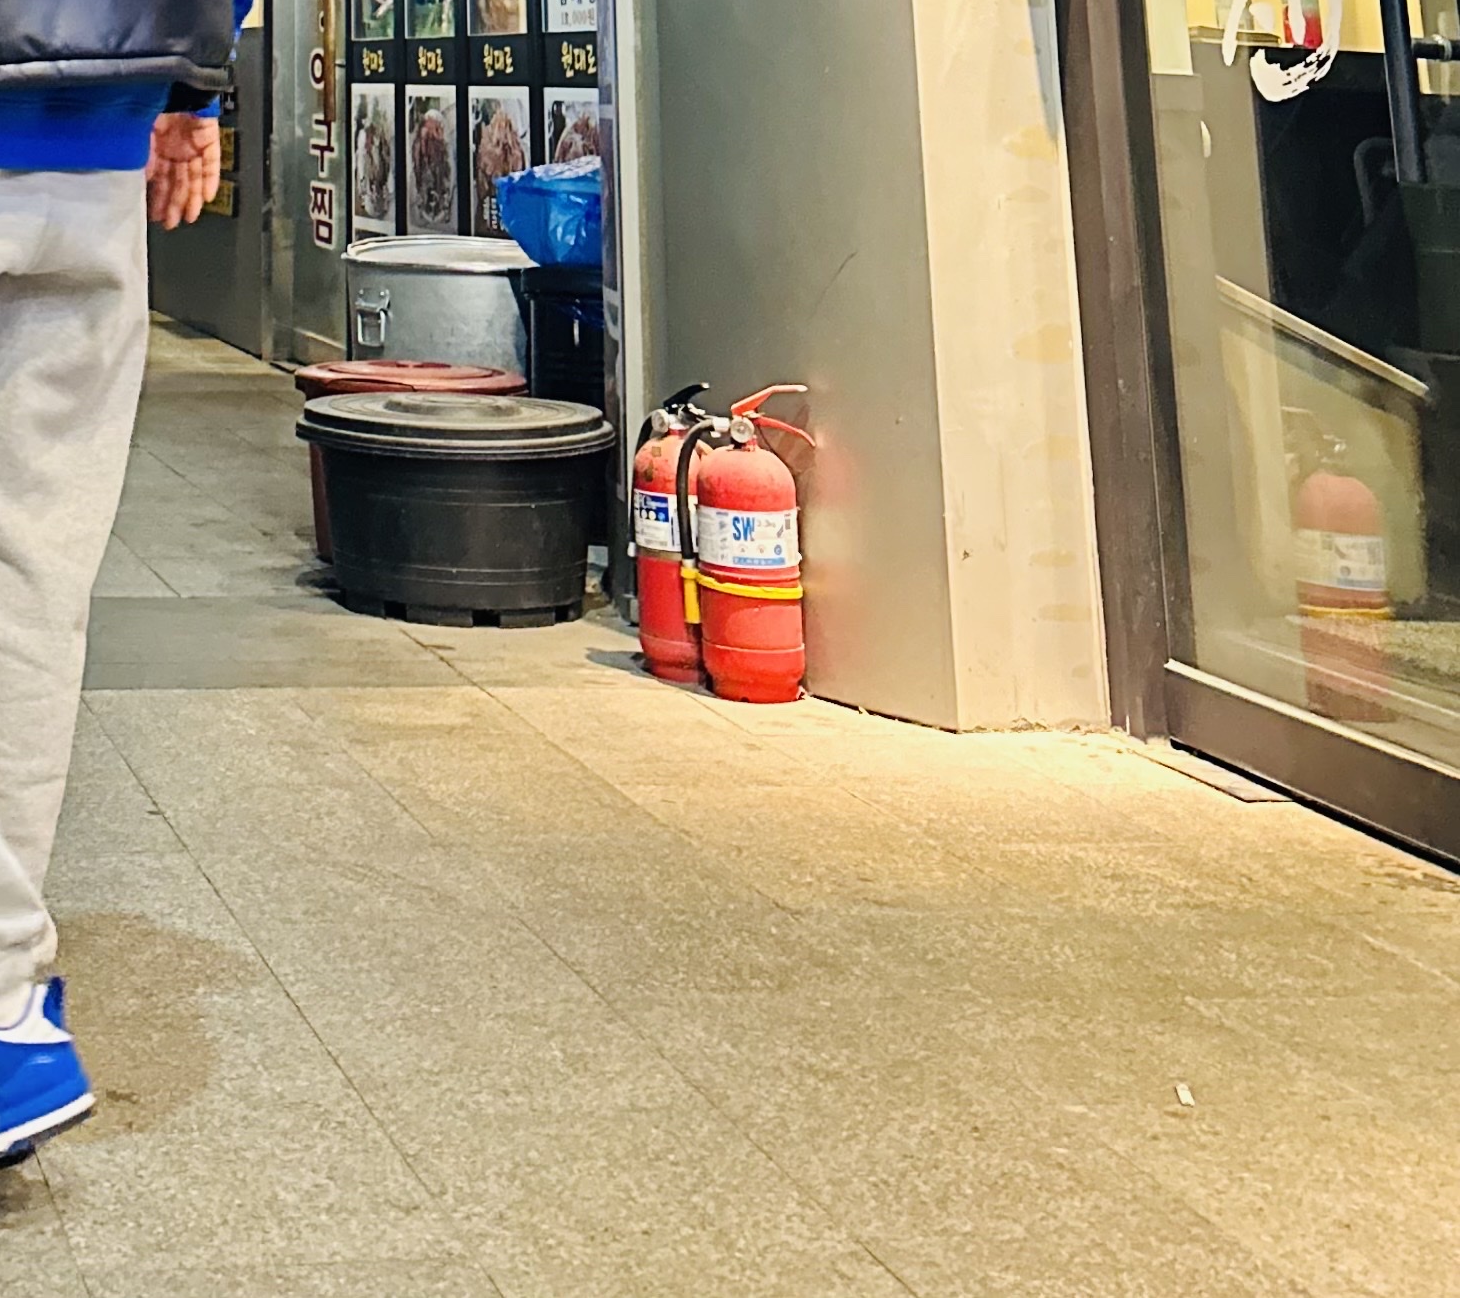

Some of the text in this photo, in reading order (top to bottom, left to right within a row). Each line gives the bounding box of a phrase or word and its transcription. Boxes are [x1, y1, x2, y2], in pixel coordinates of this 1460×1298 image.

[418, 45, 444, 77] 원대로
[483, 43, 514, 77] 원대로
[561, 41, 597, 78] 원대로
